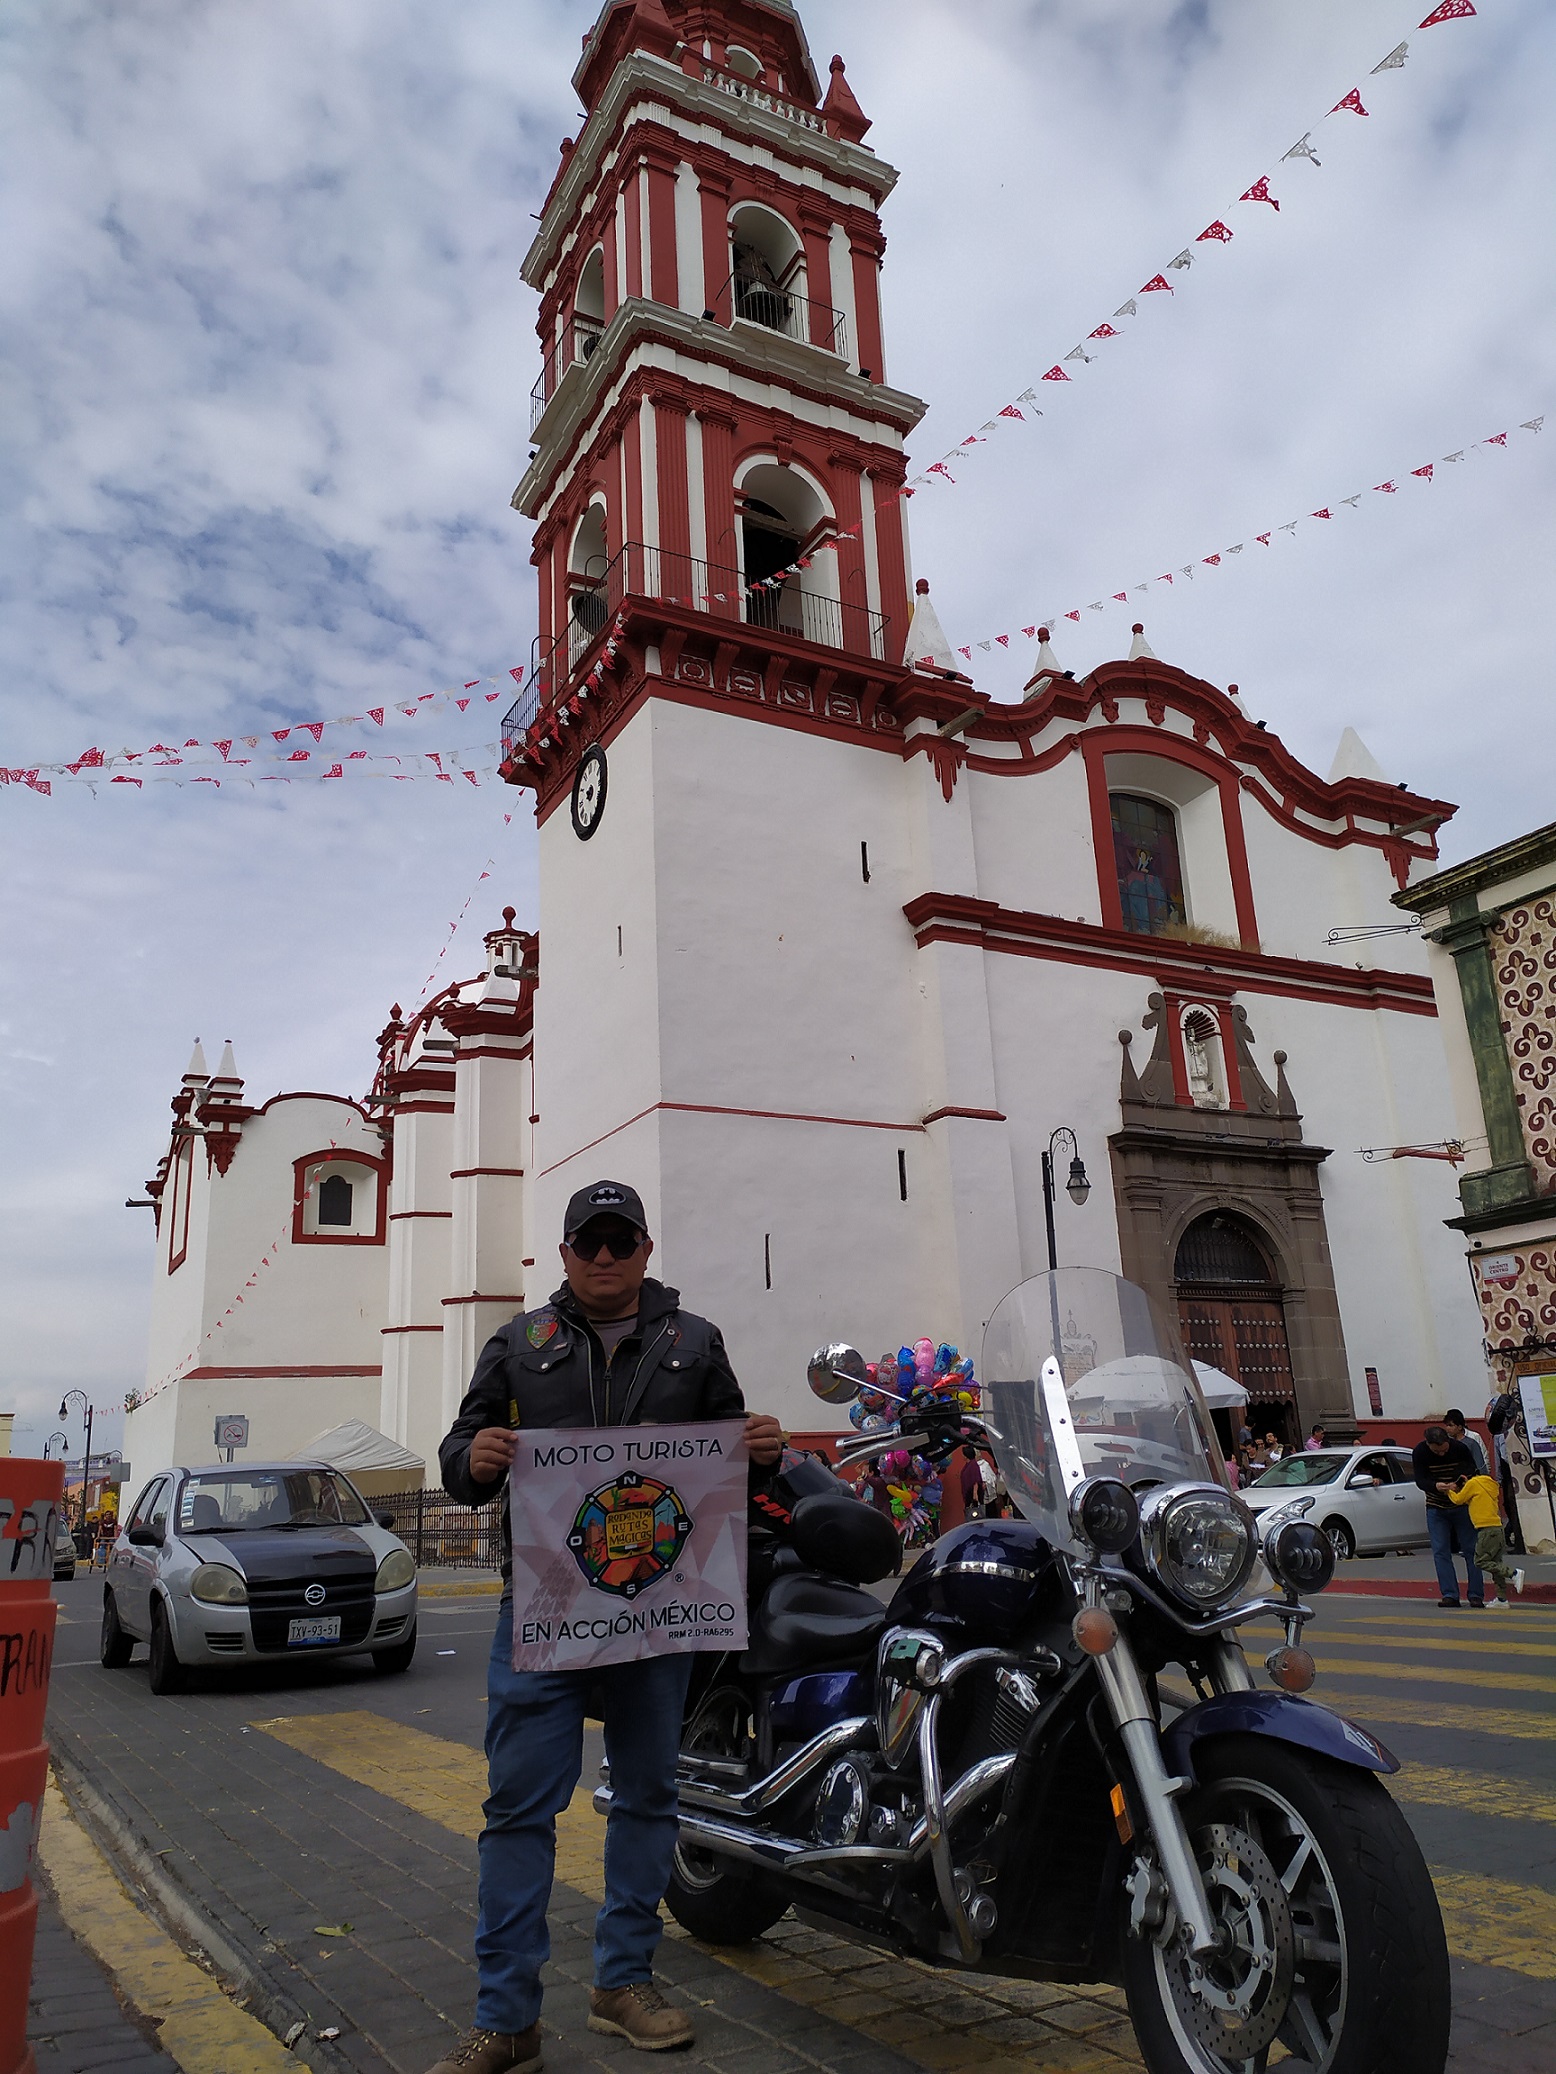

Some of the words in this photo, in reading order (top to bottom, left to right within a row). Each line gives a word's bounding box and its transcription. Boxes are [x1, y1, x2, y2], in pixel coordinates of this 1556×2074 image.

[534, 1444, 615, 1468] MOTO
[622, 1438, 723, 1461] TURISTA
[623, 1475, 637, 1485] N
[678, 1522, 689, 1531] E
[626, 1584, 636, 1594] S
[522, 1621, 551, 1644] EN
[557, 1609, 646, 1641] ACCIÓN
[650, 1600, 735, 1629] MÉXICO
[291, 1624, 338, 1639] TXV-93-51
[668, 1629, 687, 1640] RRM
